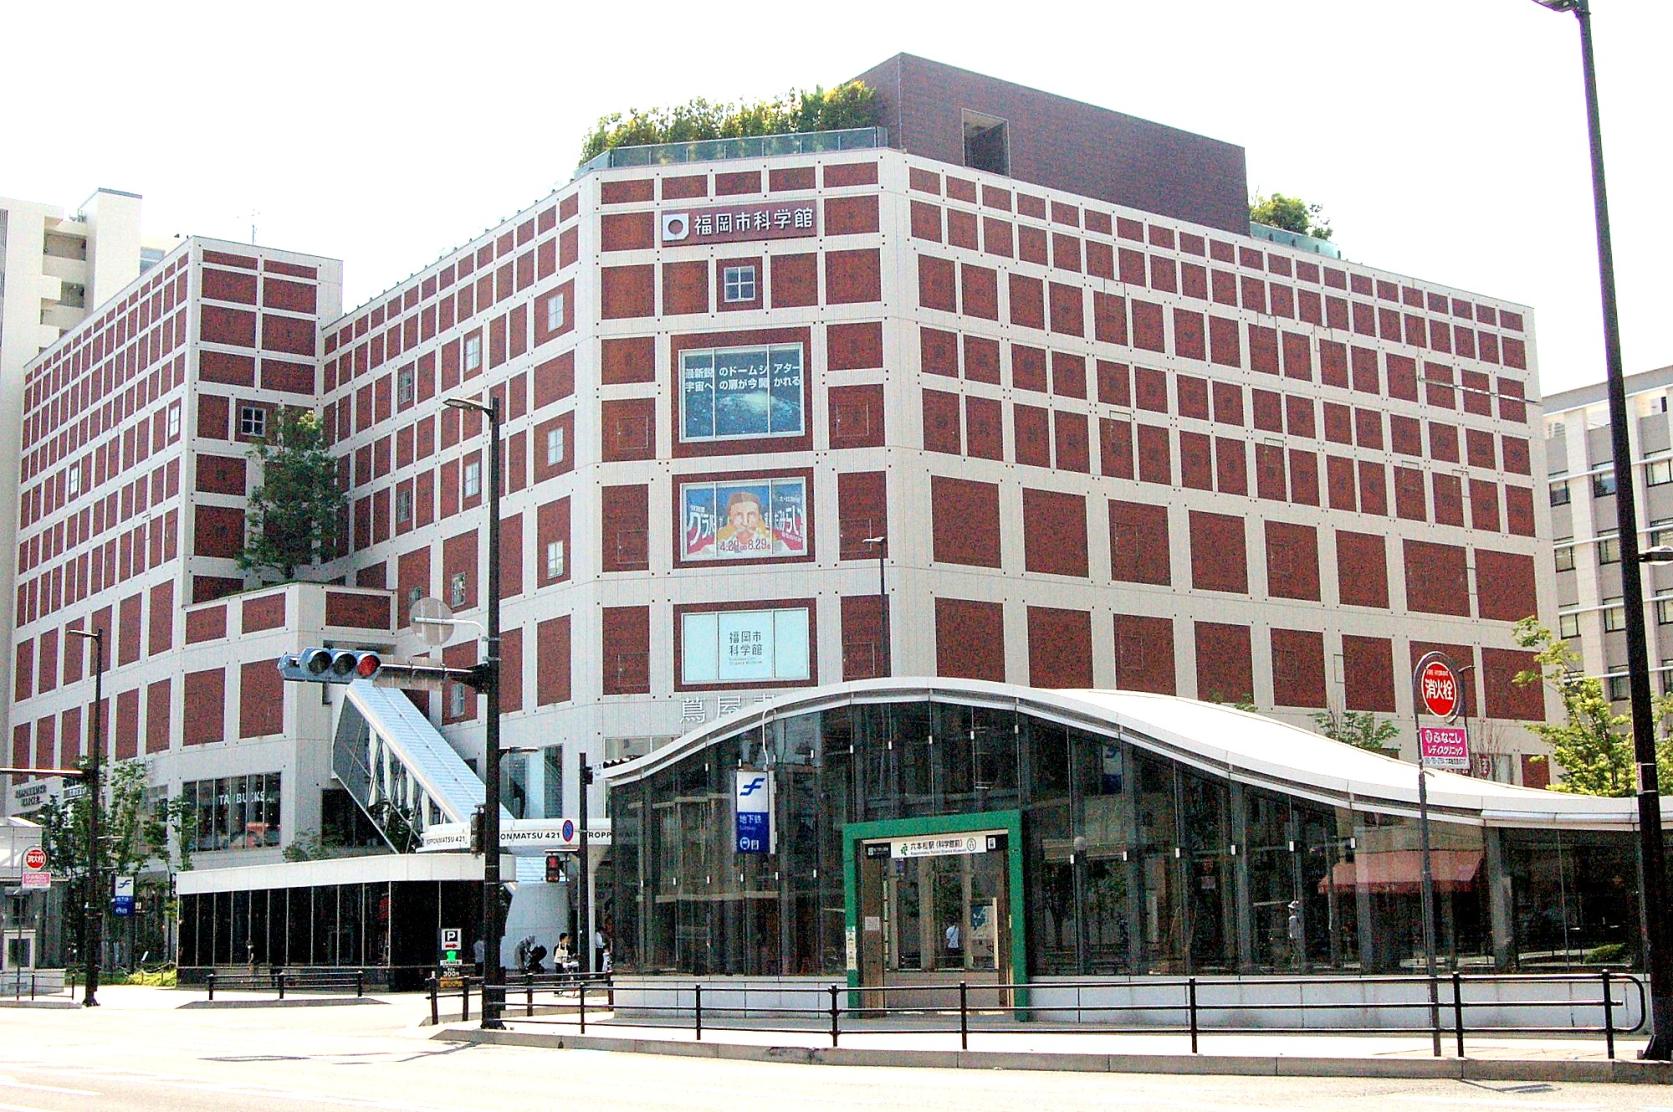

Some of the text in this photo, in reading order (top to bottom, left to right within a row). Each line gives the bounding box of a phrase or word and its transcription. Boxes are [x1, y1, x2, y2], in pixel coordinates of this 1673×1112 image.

[694, 208, 813, 235] 福岡市科学館
[729, 643, 763, 656] 科学館
[1424, 679, 1454, 700] 消火栓
[499, 832, 543, 840] ONMATSU
[447, 932, 456, 941] P
